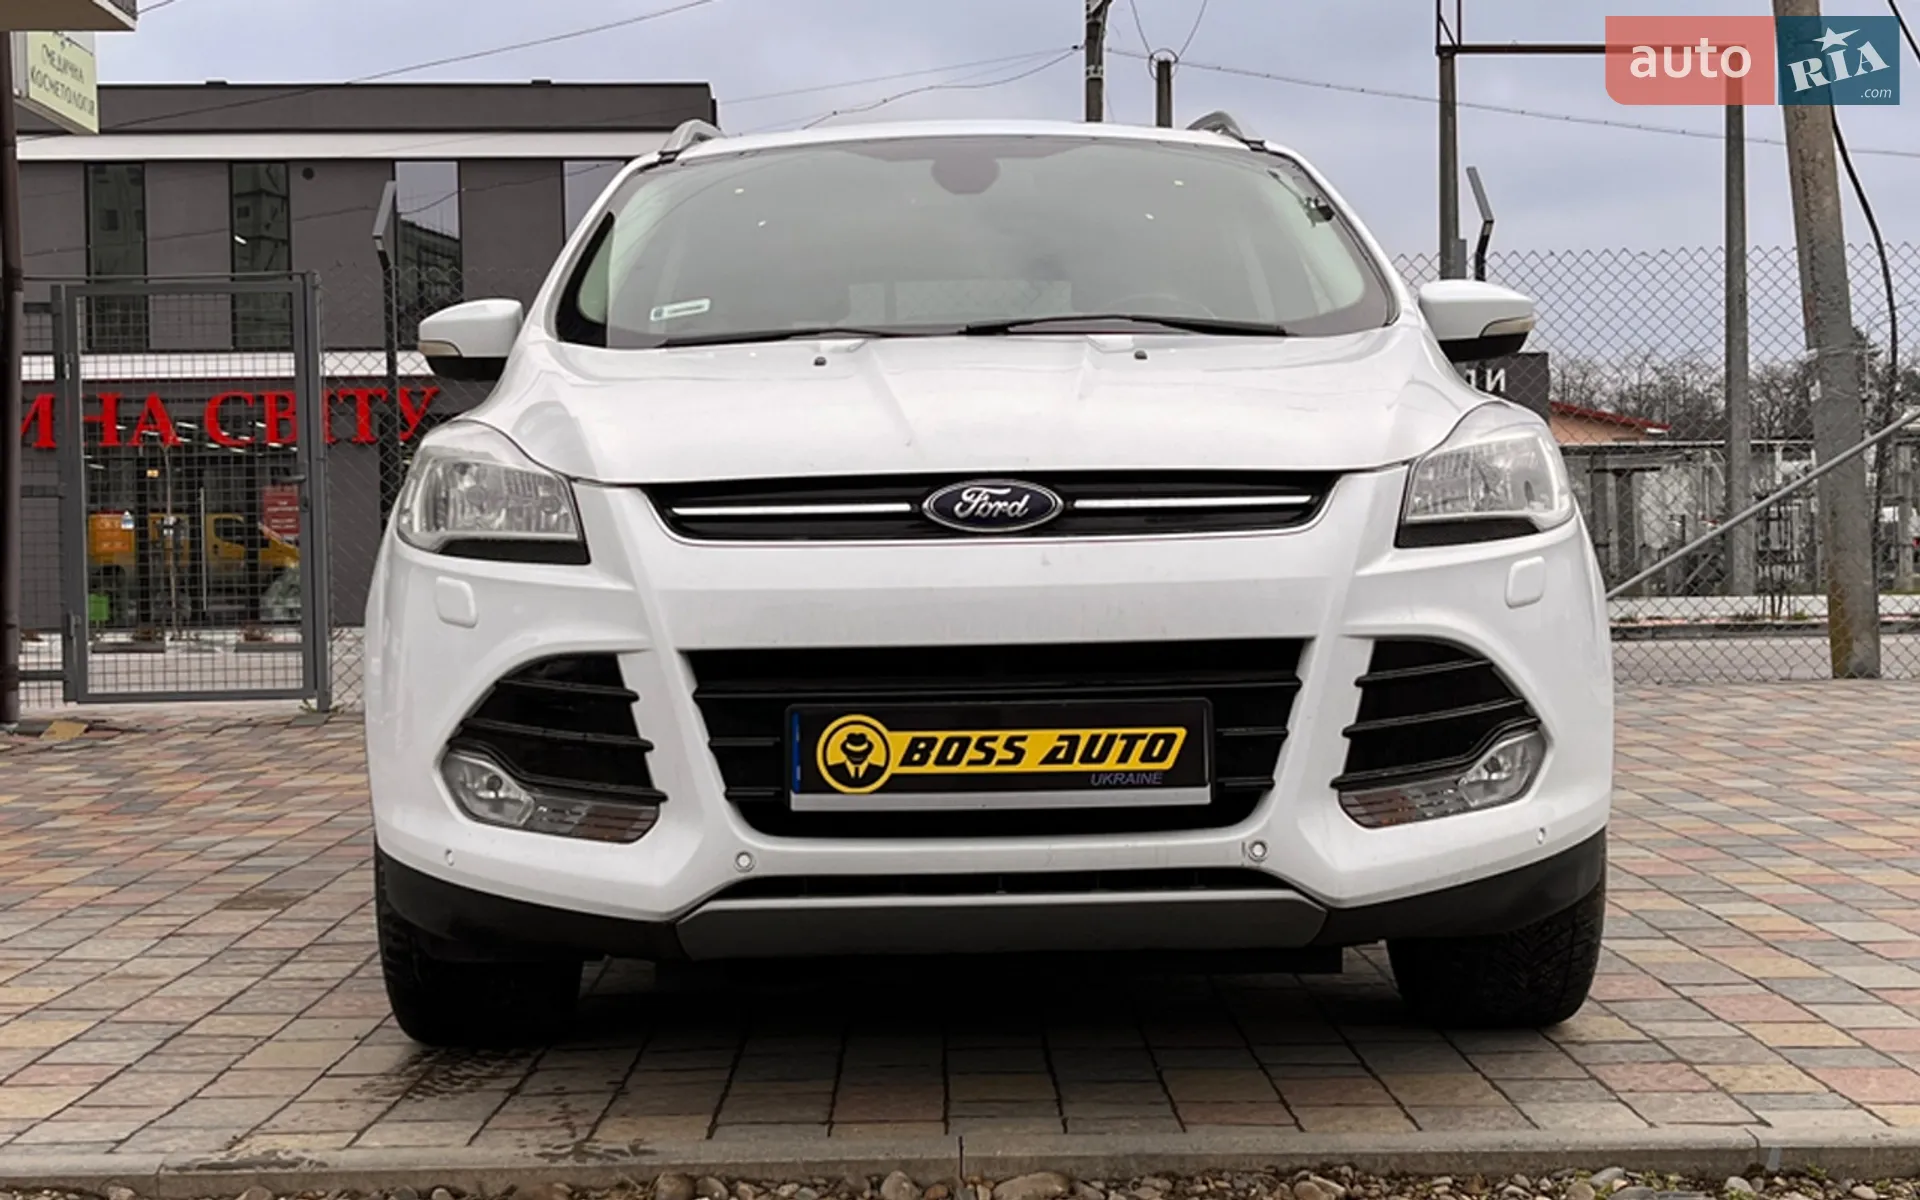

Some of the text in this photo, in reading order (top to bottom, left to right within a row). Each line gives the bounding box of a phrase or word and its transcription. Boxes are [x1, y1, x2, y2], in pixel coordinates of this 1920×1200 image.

[954, 487, 1030, 518] Ford
[898, 732, 1178, 767] BOSS AUTO
[1090, 772, 1163, 786] UKRAINE
